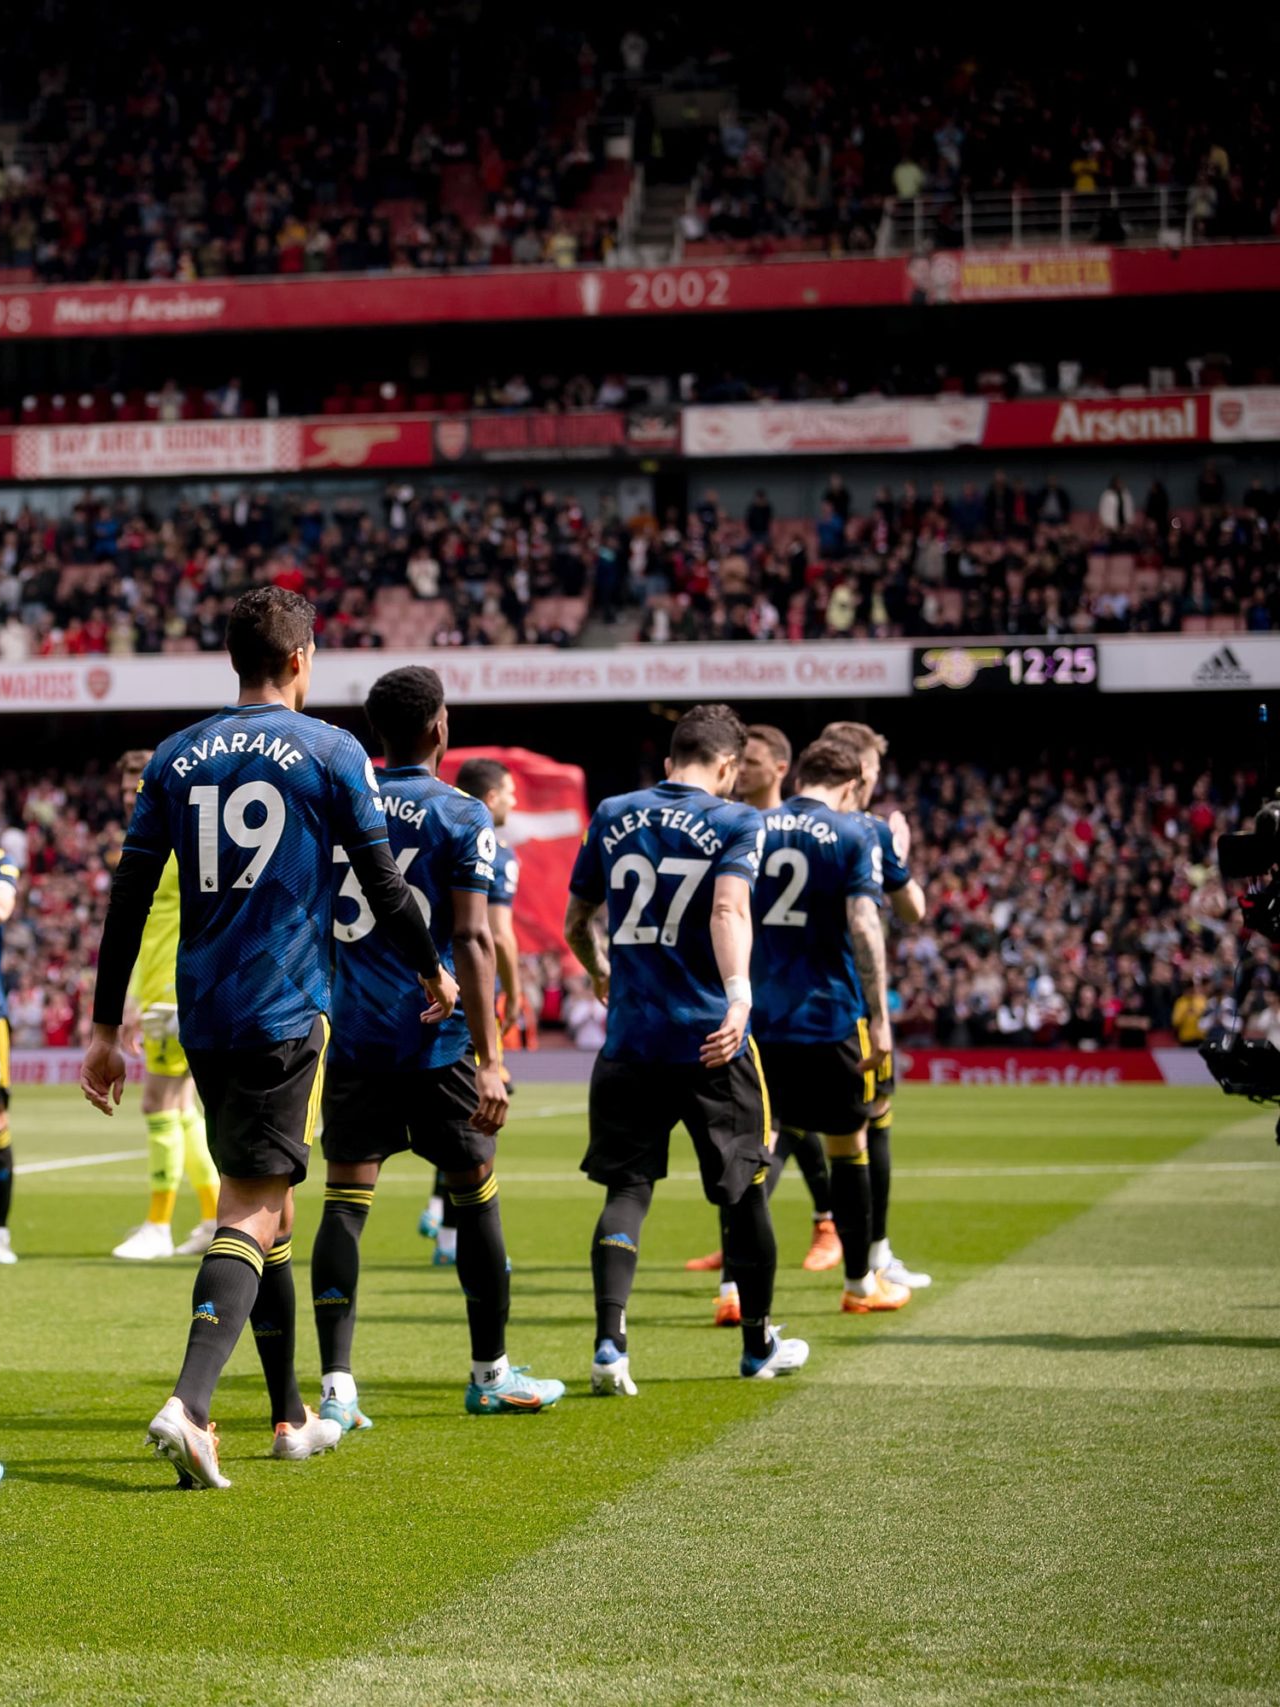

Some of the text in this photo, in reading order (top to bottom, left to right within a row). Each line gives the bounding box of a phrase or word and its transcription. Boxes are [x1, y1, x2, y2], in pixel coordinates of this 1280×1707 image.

[625, 269, 731, 309] 2002
[1051, 397, 1197, 443] Arsenal
[480, 660, 599, 690] Emirates
[606, 663, 637, 687] to
[644, 656, 688, 684] the
[697, 655, 787, 684] Indian
[794, 653, 888, 685] Ocean
[1005, 646, 1098, 685] 12:25
[172, 732, 303, 779] R.VARANE
[189, 780, 286, 893] 19
[602, 807, 723, 856] ALEX TELLES
[610, 853, 713, 947] 27
[761, 847, 809, 928] 2
